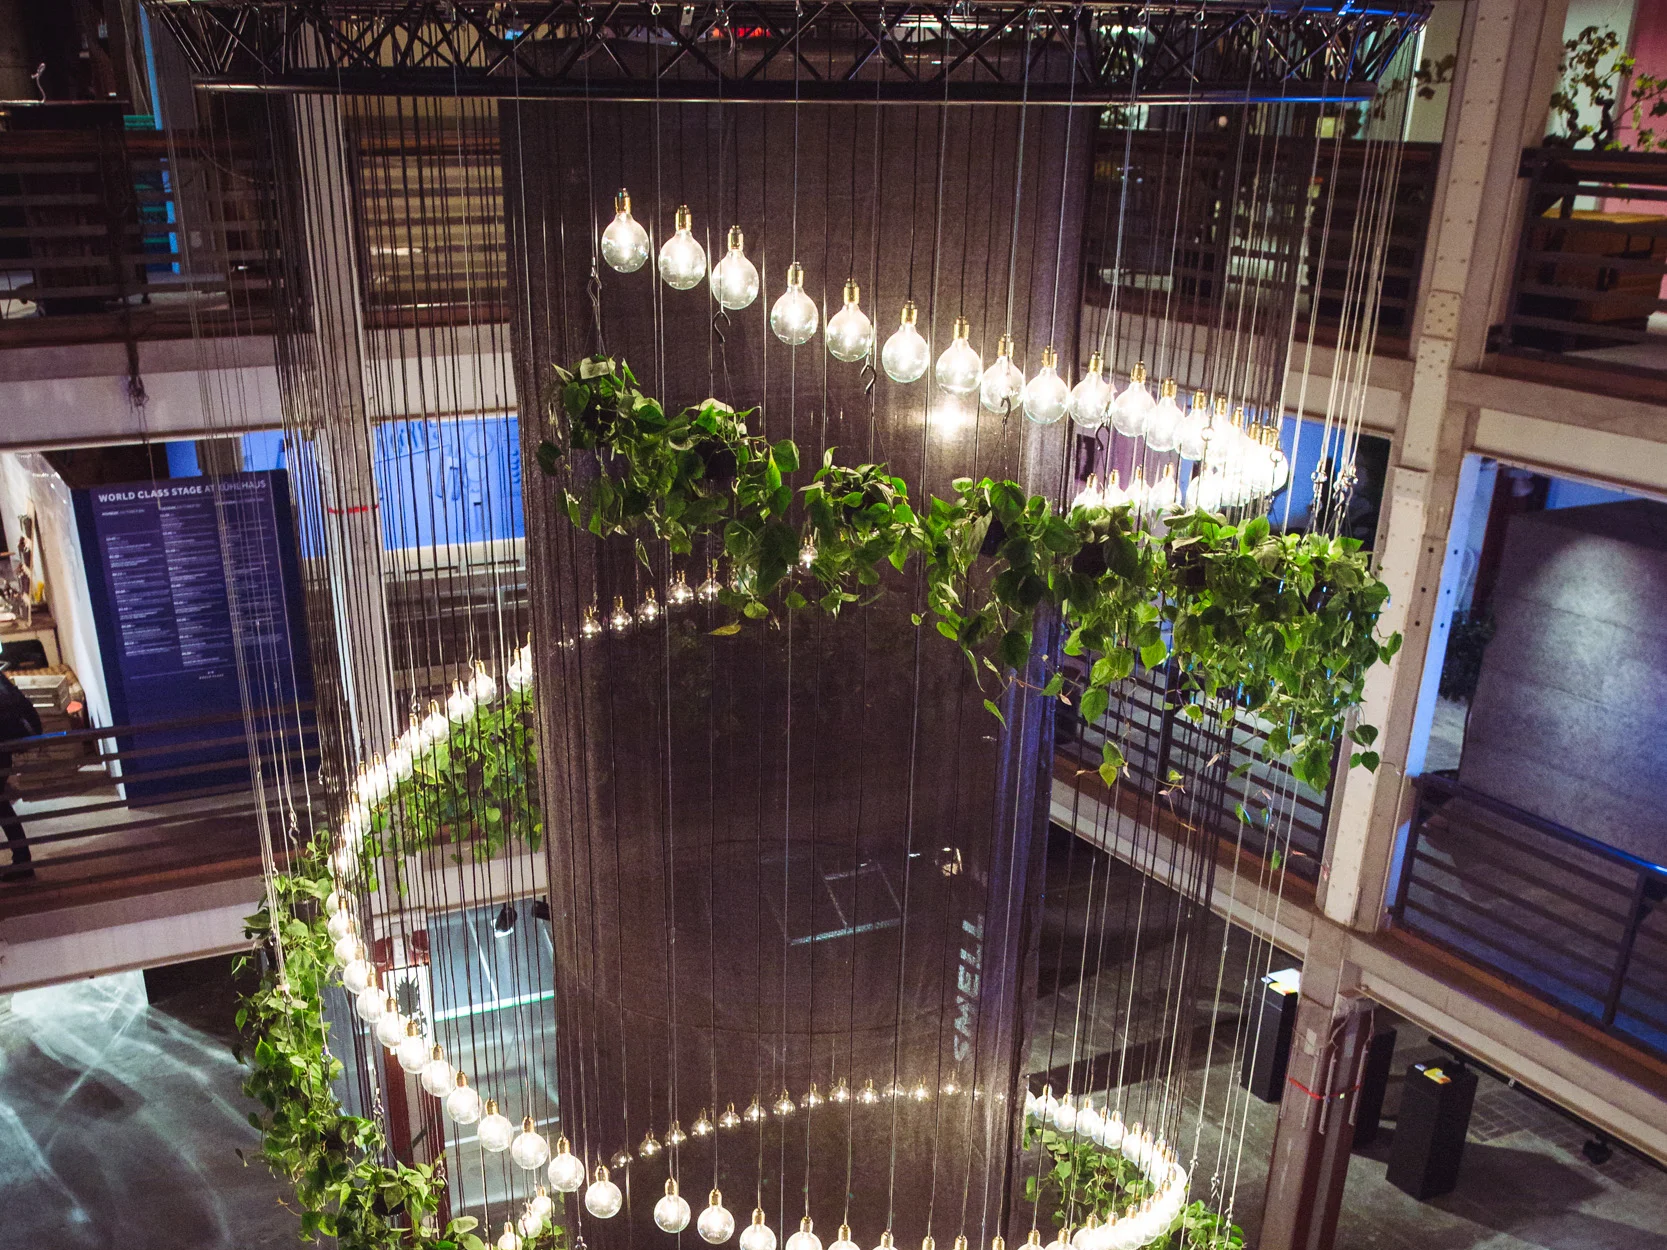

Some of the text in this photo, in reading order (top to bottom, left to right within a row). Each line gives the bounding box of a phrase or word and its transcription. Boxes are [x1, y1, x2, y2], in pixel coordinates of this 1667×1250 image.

[98, 491, 136, 503] WORLD
[137, 488, 170, 500] CLASS
[171, 486, 203, 496] STAGE
[204, 484, 215, 493] AT
